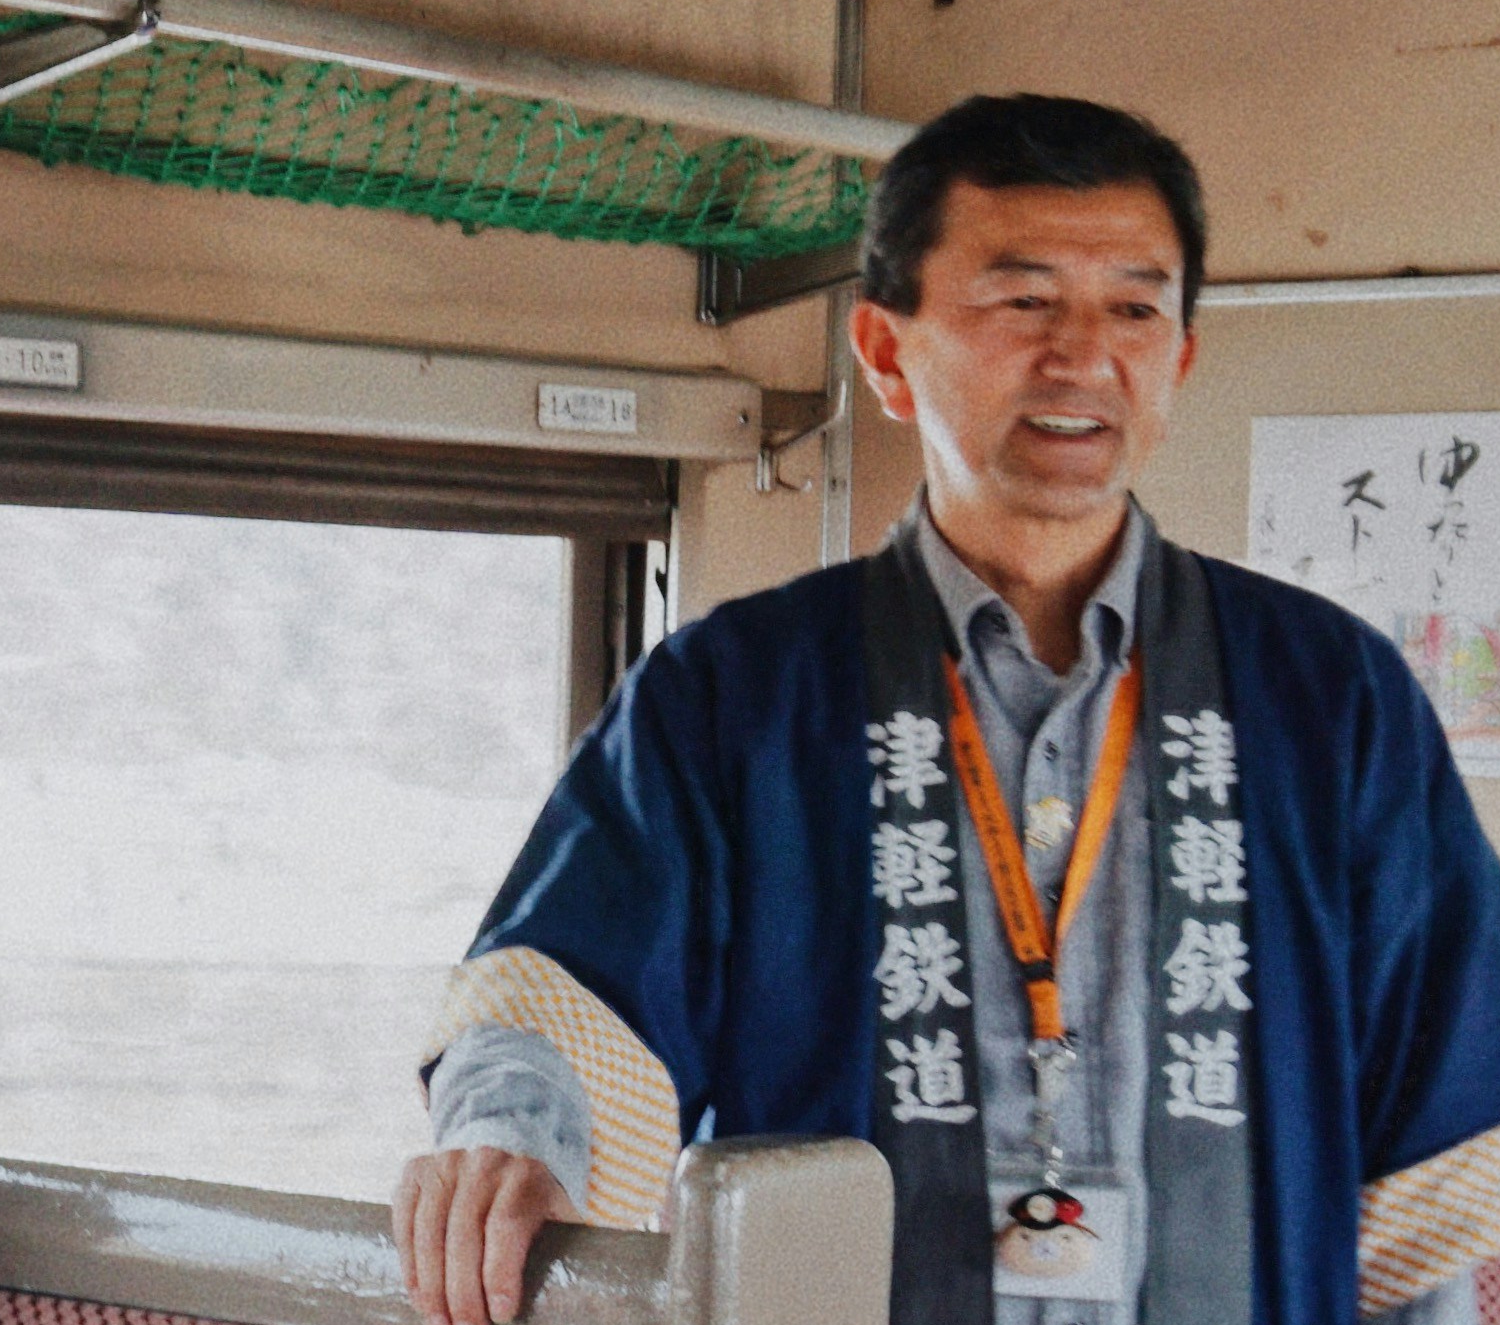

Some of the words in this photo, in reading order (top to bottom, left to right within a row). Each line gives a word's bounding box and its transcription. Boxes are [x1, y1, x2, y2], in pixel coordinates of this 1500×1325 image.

[865, 710, 978, 1126] 津軽鉄道
[1160, 708, 1254, 1129] 津軽鉄道
